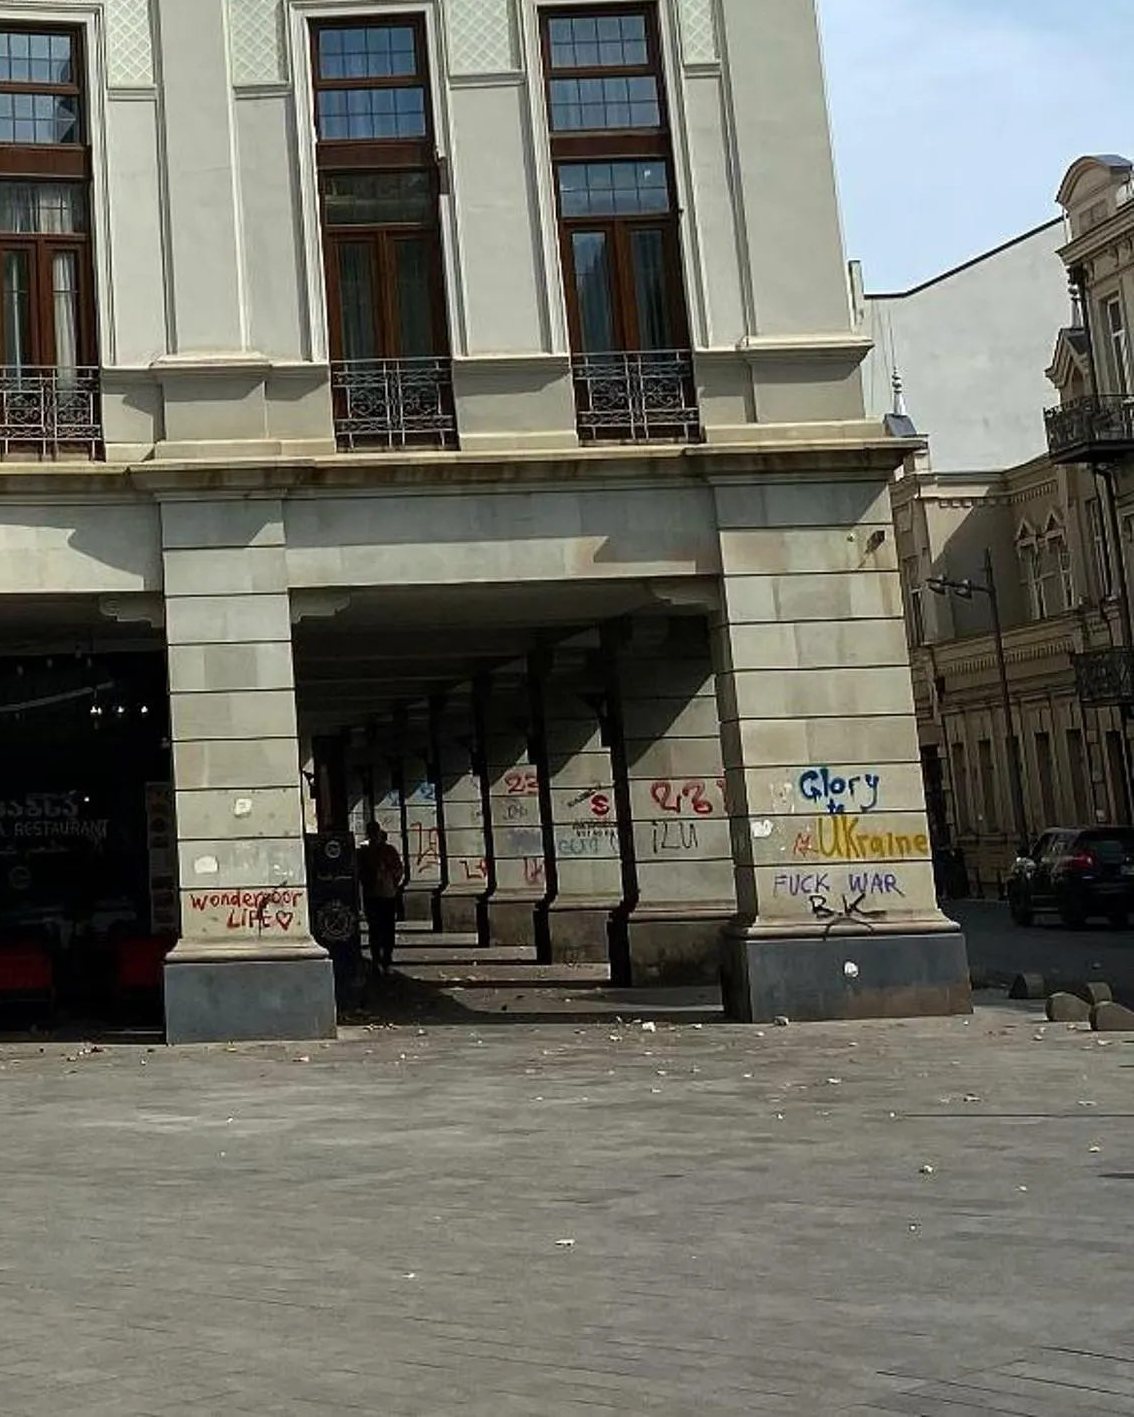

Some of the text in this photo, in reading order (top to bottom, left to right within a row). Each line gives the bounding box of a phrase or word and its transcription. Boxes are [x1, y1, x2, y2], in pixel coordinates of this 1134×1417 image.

[800, 769, 879, 813] Glory
[13, 816, 112, 840] RESTAURANT
[773, 873, 905, 899] FUCK WAR
